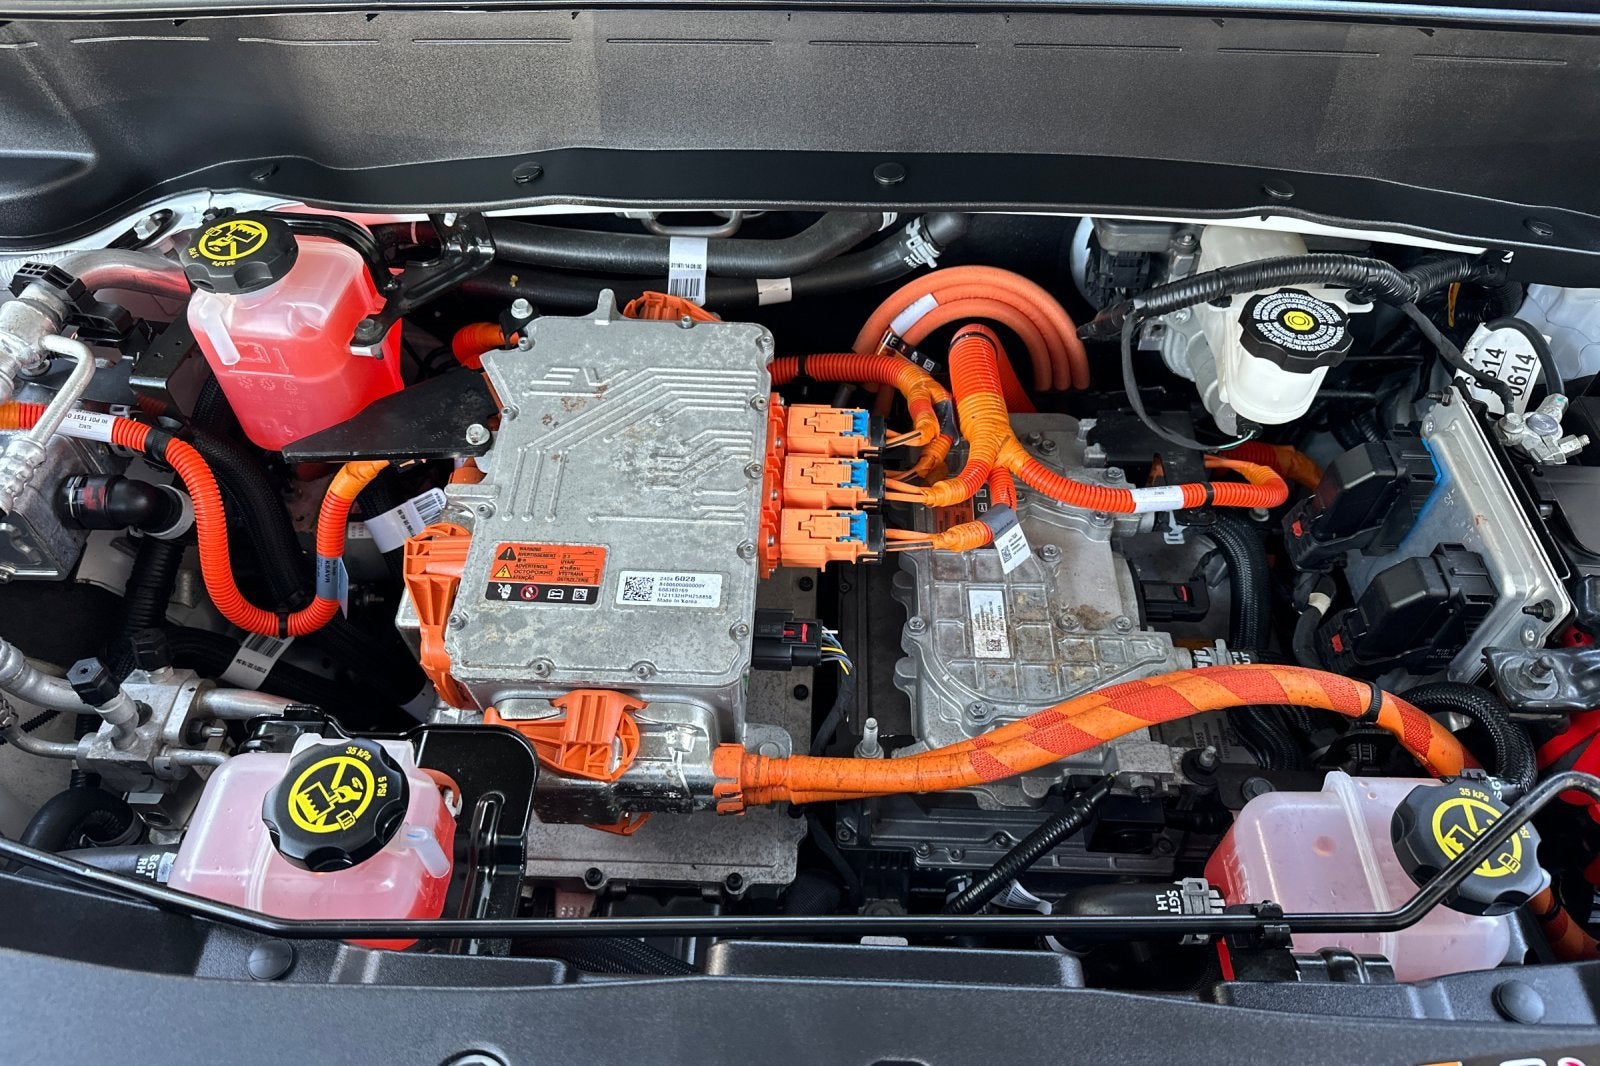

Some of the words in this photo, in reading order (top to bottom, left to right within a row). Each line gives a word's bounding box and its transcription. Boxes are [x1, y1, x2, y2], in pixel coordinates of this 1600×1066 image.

[346, 747, 356, 755] 35
[357, 748, 372, 761] kPa
[377, 782, 388, 797] PSI
[1459, 787, 1471, 797] 35
[1472, 790, 1490, 803] kPa
[136, 858, 149, 874] RH
[145, 854, 160, 879] SGT
[1155, 894, 1168, 911] LH
[1167, 890, 1182, 914] SGT
